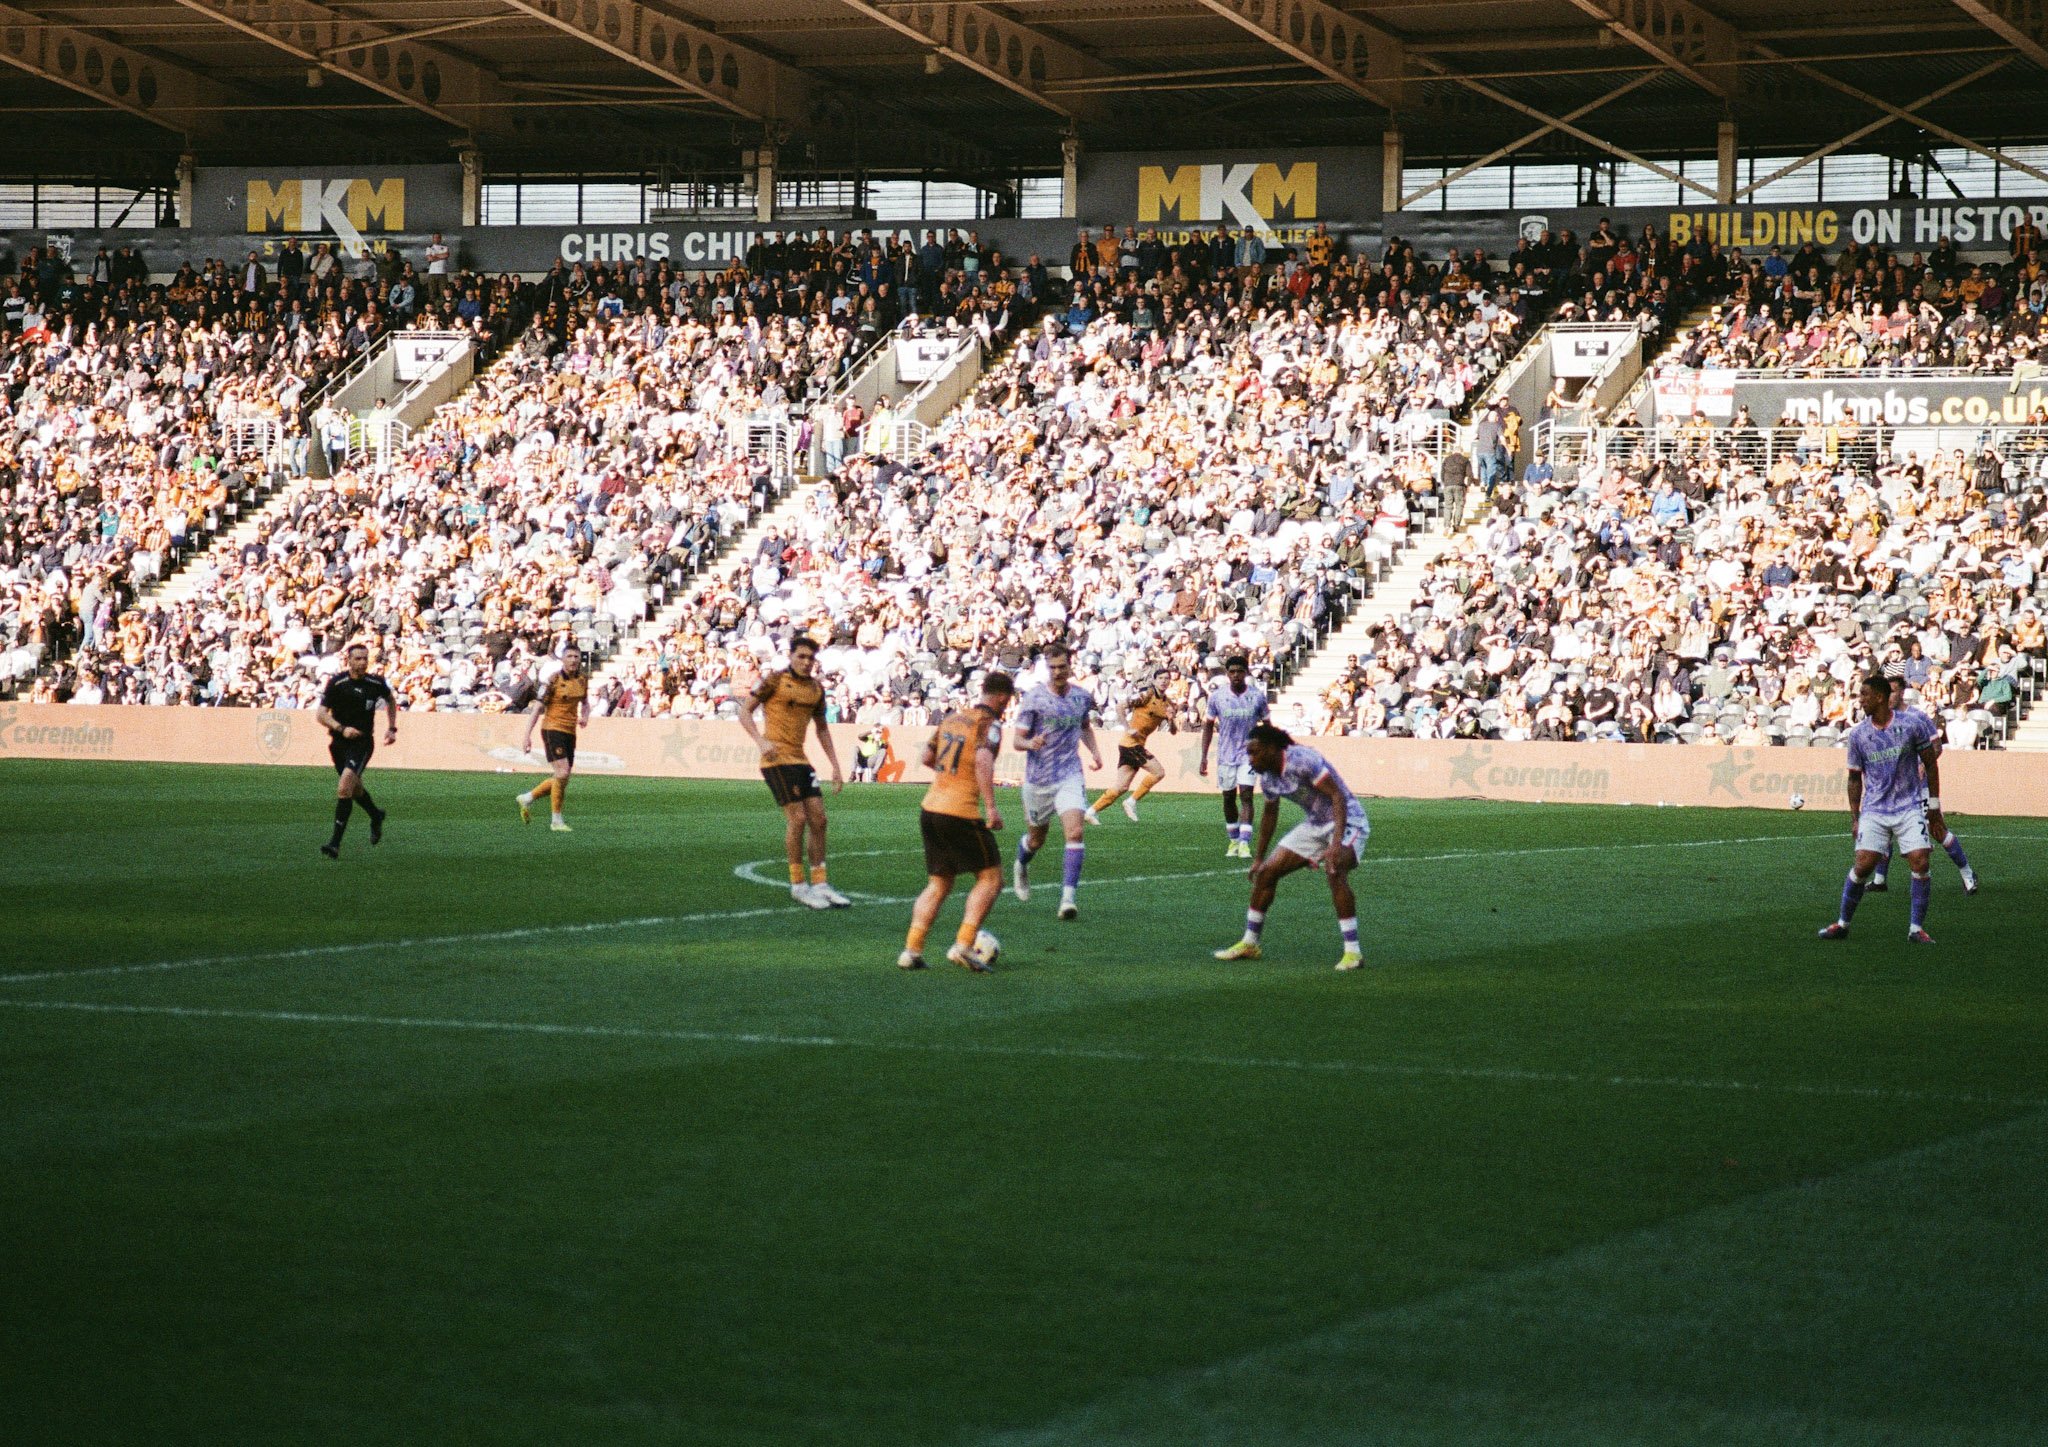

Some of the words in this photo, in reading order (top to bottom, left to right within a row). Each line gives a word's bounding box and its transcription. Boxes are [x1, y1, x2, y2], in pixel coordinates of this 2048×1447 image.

[247, 178, 405, 259] MKM
[1138, 162, 1317, 249] MKM
[1228, 228, 1316, 244] SPPLIES
[1669, 210, 1839, 247] BUILDING
[1851, 208, 1901, 244] ON
[560, 231, 670, 262] CHRIS
[683, 230, 835, 261] CHILT
[14, 720, 115, 745] corendon
[695, 743, 762, 764] coren
[1487, 761, 1610, 790] corendon
[1749, 767, 1848, 795] corend
